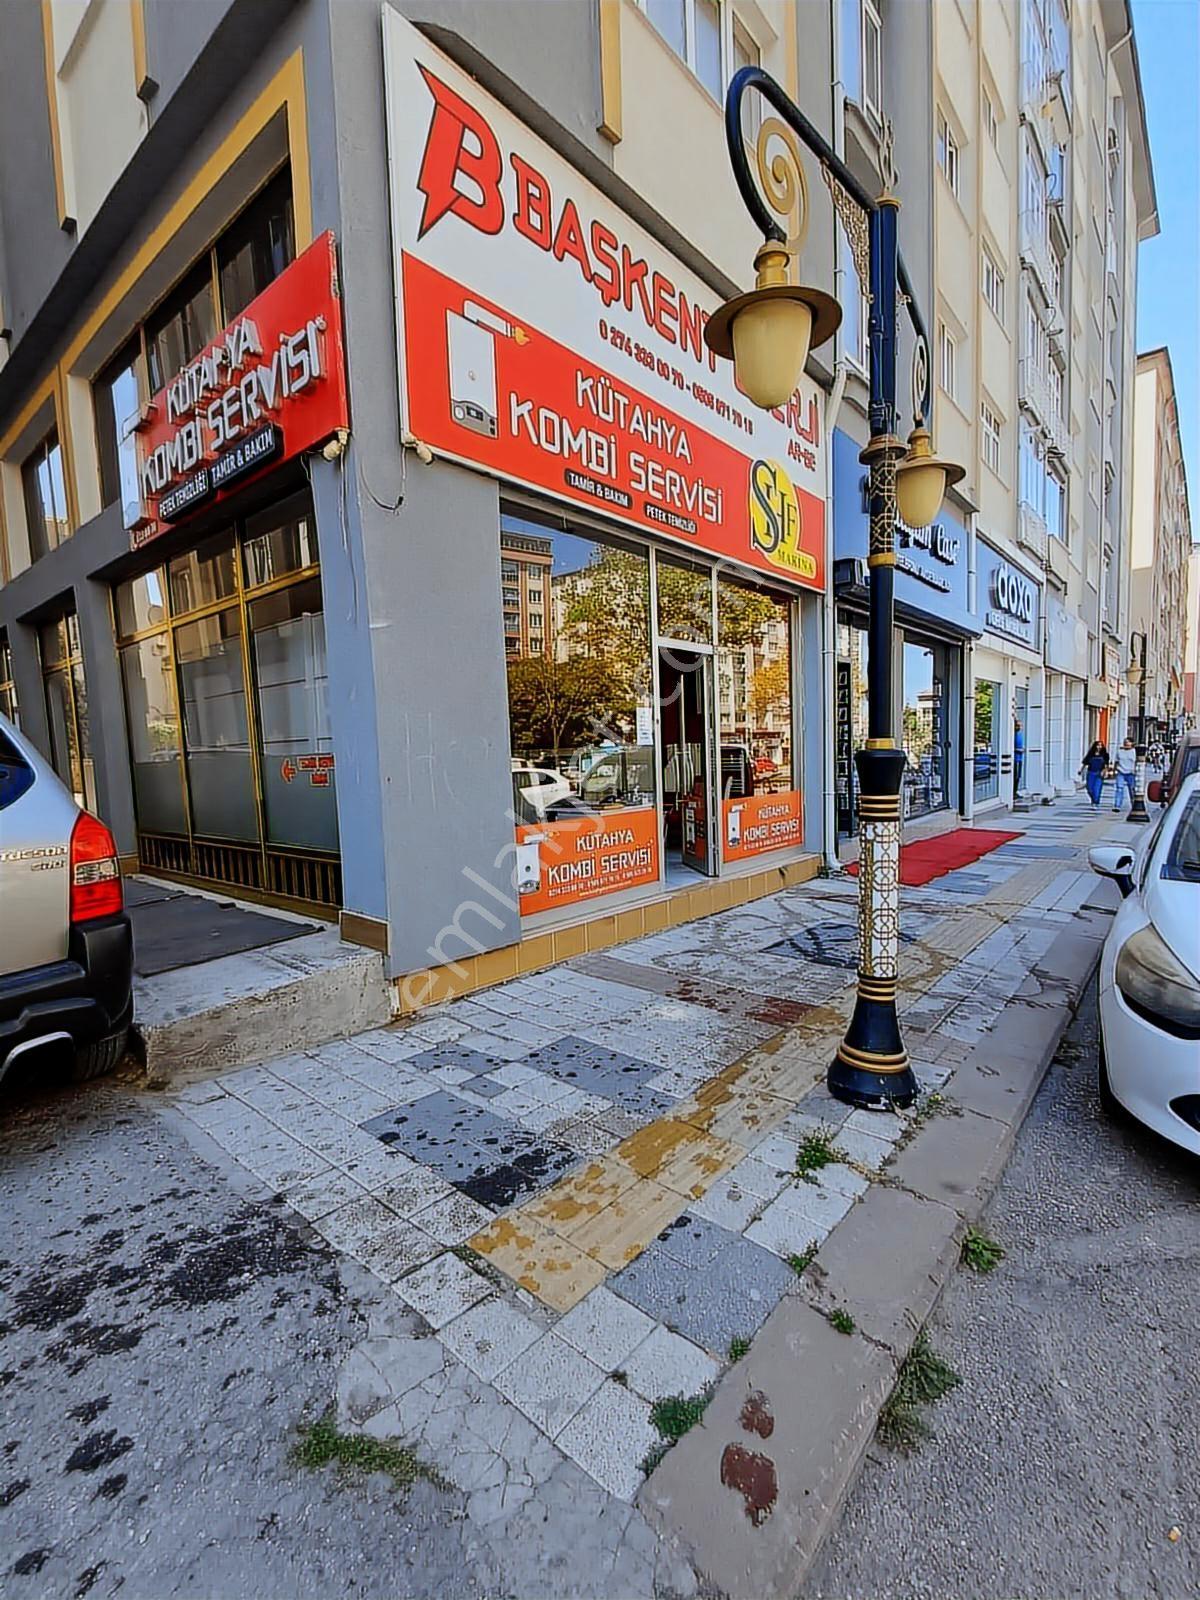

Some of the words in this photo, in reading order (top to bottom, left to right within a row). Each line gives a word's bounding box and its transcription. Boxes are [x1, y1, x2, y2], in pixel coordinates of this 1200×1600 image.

[167, 317, 263, 423] KÜTAHYA
[576, 368, 693, 466] KÜTAHYA
[142, 408, 206, 500] KOMBİ
[509, 390, 618, 480] KOMBİ
[629, 449, 724, 525] SERVİSİ
[548, 853, 595, 886] KOMBİ
[601, 842, 652, 874] SERVİSİ
[576, 829, 634, 852] KÜTAHYA
